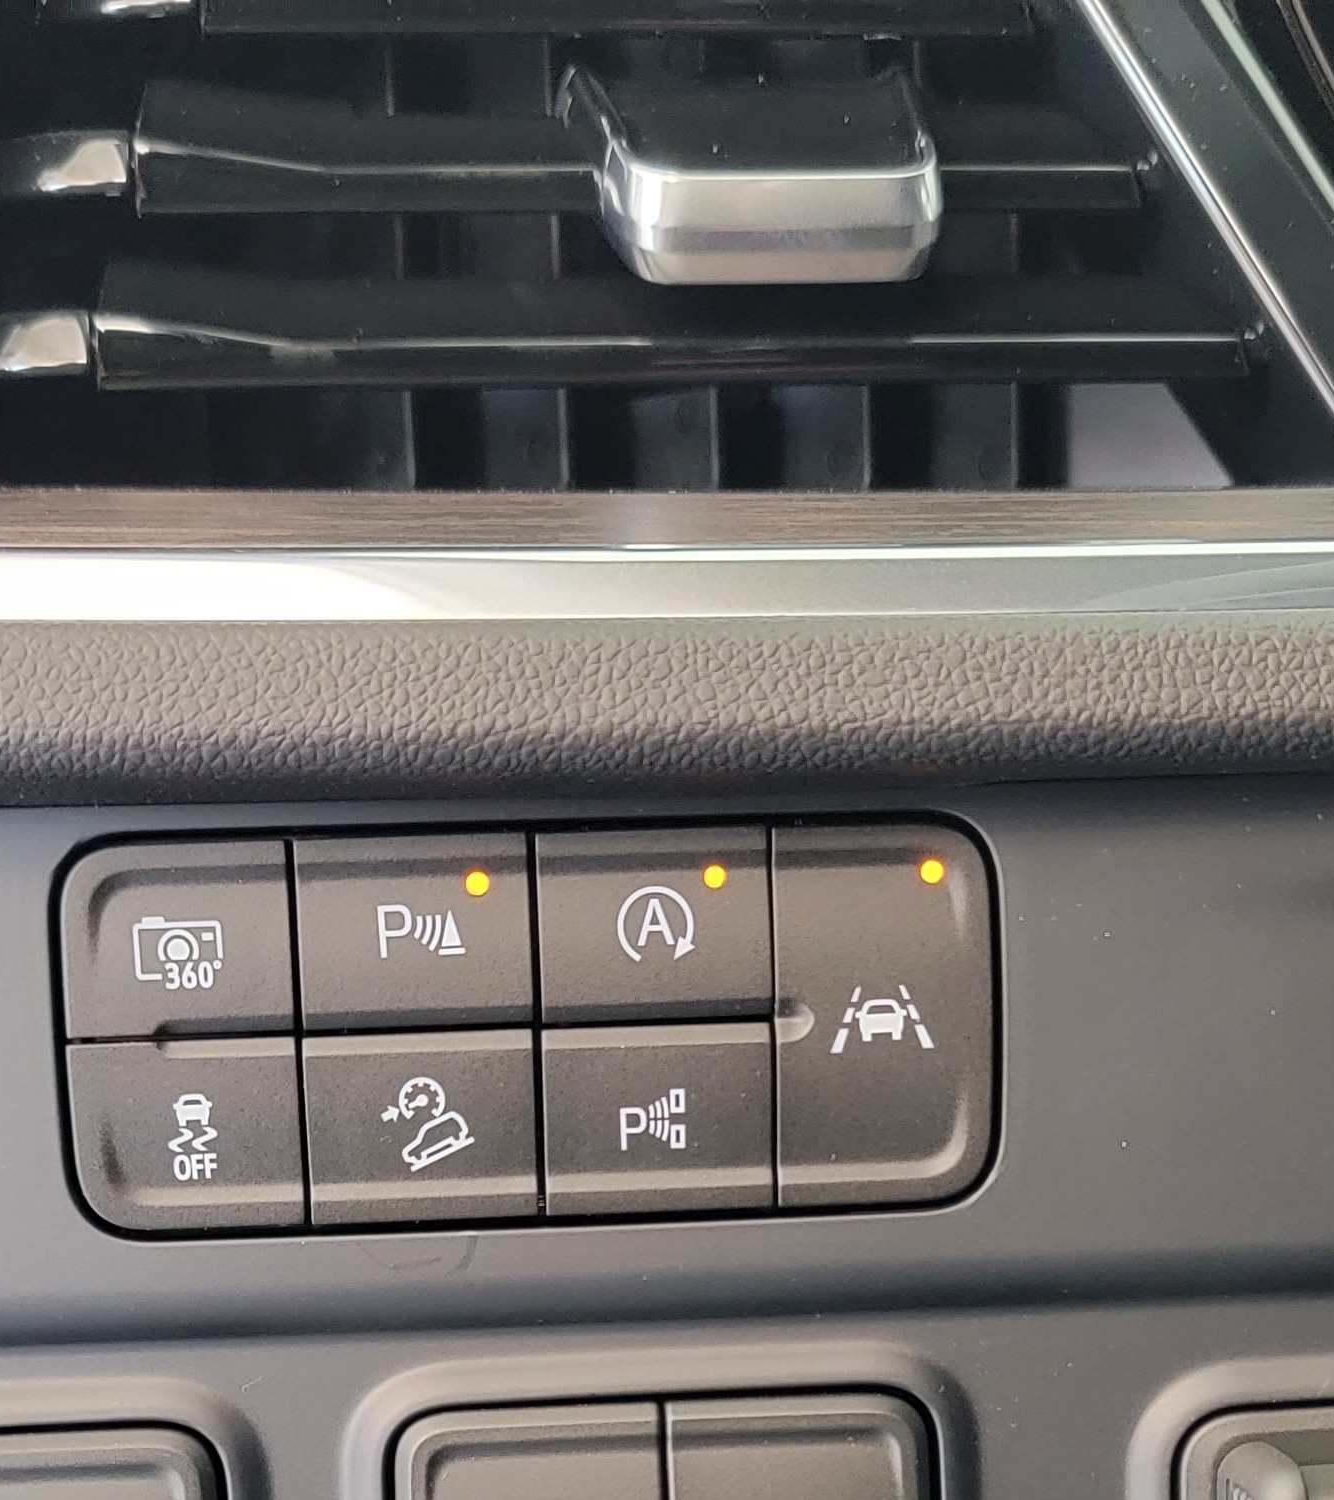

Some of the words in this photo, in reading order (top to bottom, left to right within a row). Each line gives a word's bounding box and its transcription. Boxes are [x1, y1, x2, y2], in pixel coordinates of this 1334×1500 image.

[376, 904, 412, 959] P
[636, 898, 674, 945] A
[619, 1106, 647, 1151] P
[173, 1152, 218, 1181] OFF
